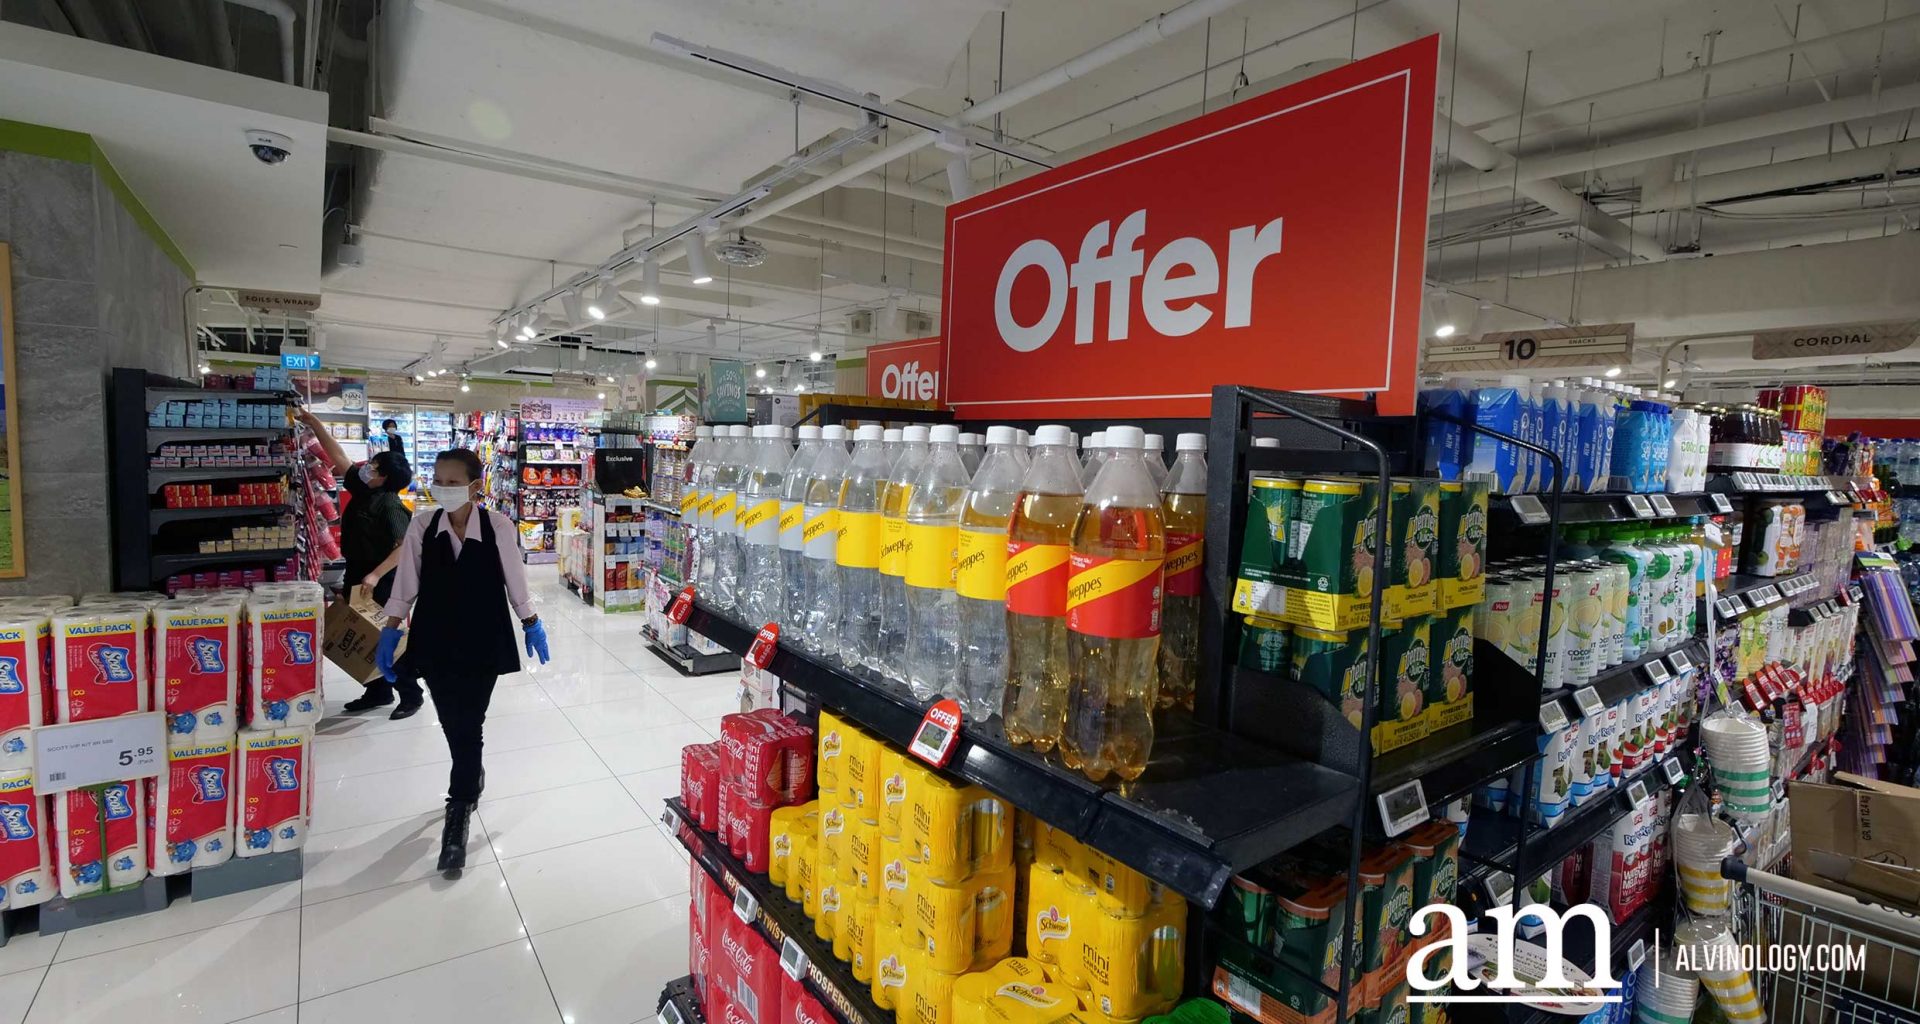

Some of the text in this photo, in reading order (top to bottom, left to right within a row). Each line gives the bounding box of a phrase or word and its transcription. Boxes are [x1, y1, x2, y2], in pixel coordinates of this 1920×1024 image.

[994, 208, 1283, 353] Offer
[283, 297, 315, 306] WRAPS
[1504, 338, 1536, 360] 10
[1568, 337, 1597, 345] SNACKS
[1793, 334, 1872, 347] CORDIAL
[716, 384, 742, 400] SAVINGS
[679, 591, 692, 602] OFFER
[169, 617, 225, 627] VALUE PACK
[263, 610, 314, 620] VALUE PACK
[69, 623, 132, 635] VALUE PACK
[759, 628, 776, 641] OFFER
[103, 650, 129, 679] Scott
[930, 708, 957, 727] OFFER
[173, 745, 228, 758] VALUE PACK
[249, 737, 300, 748] VALUE PACK
[118, 746, 154, 767] 5.95
[849, 755, 865, 773] mini
[2, 778, 31, 789] PACK
[914, 802, 931, 824] mini
[851, 834, 869, 855] mini
[917, 892, 936, 919] mini
[847, 915, 864, 937] mini
[722, 927, 757, 976] Coca-Cola
[1082, 941, 1110, 972] mini
[1010, 959, 1032, 976] mini
[806, 959, 865, 1024] PROSPEROUS
[725, 1003, 748, 1024] Coca
[795, 1001, 818, 1024] Coca
[915, 991, 937, 1020] mini
